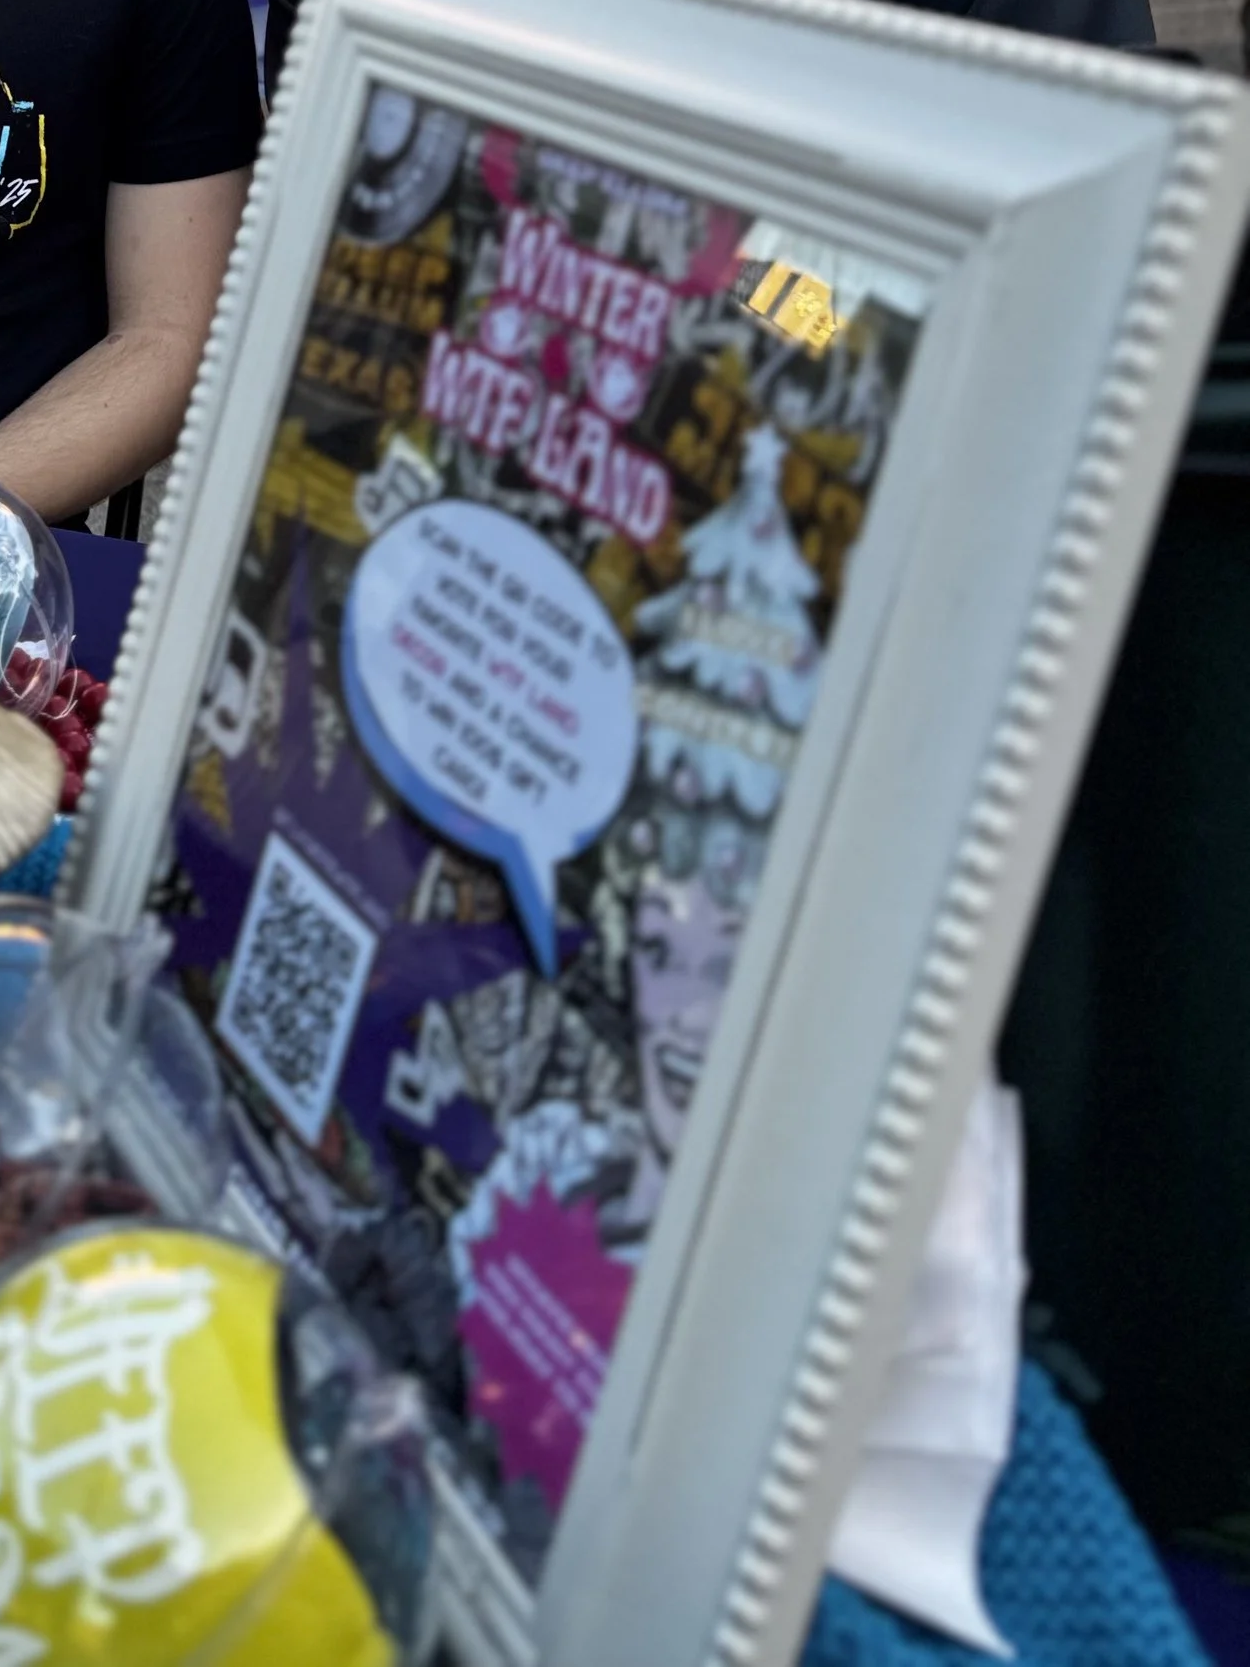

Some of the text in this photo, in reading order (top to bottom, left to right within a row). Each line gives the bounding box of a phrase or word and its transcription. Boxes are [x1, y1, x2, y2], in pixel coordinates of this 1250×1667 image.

[501, 207, 672, 359] WINTER
[302, 336, 413, 411] EXAS
[424, 330, 535, 452] WTF
[530, 393, 670, 542] LAND
